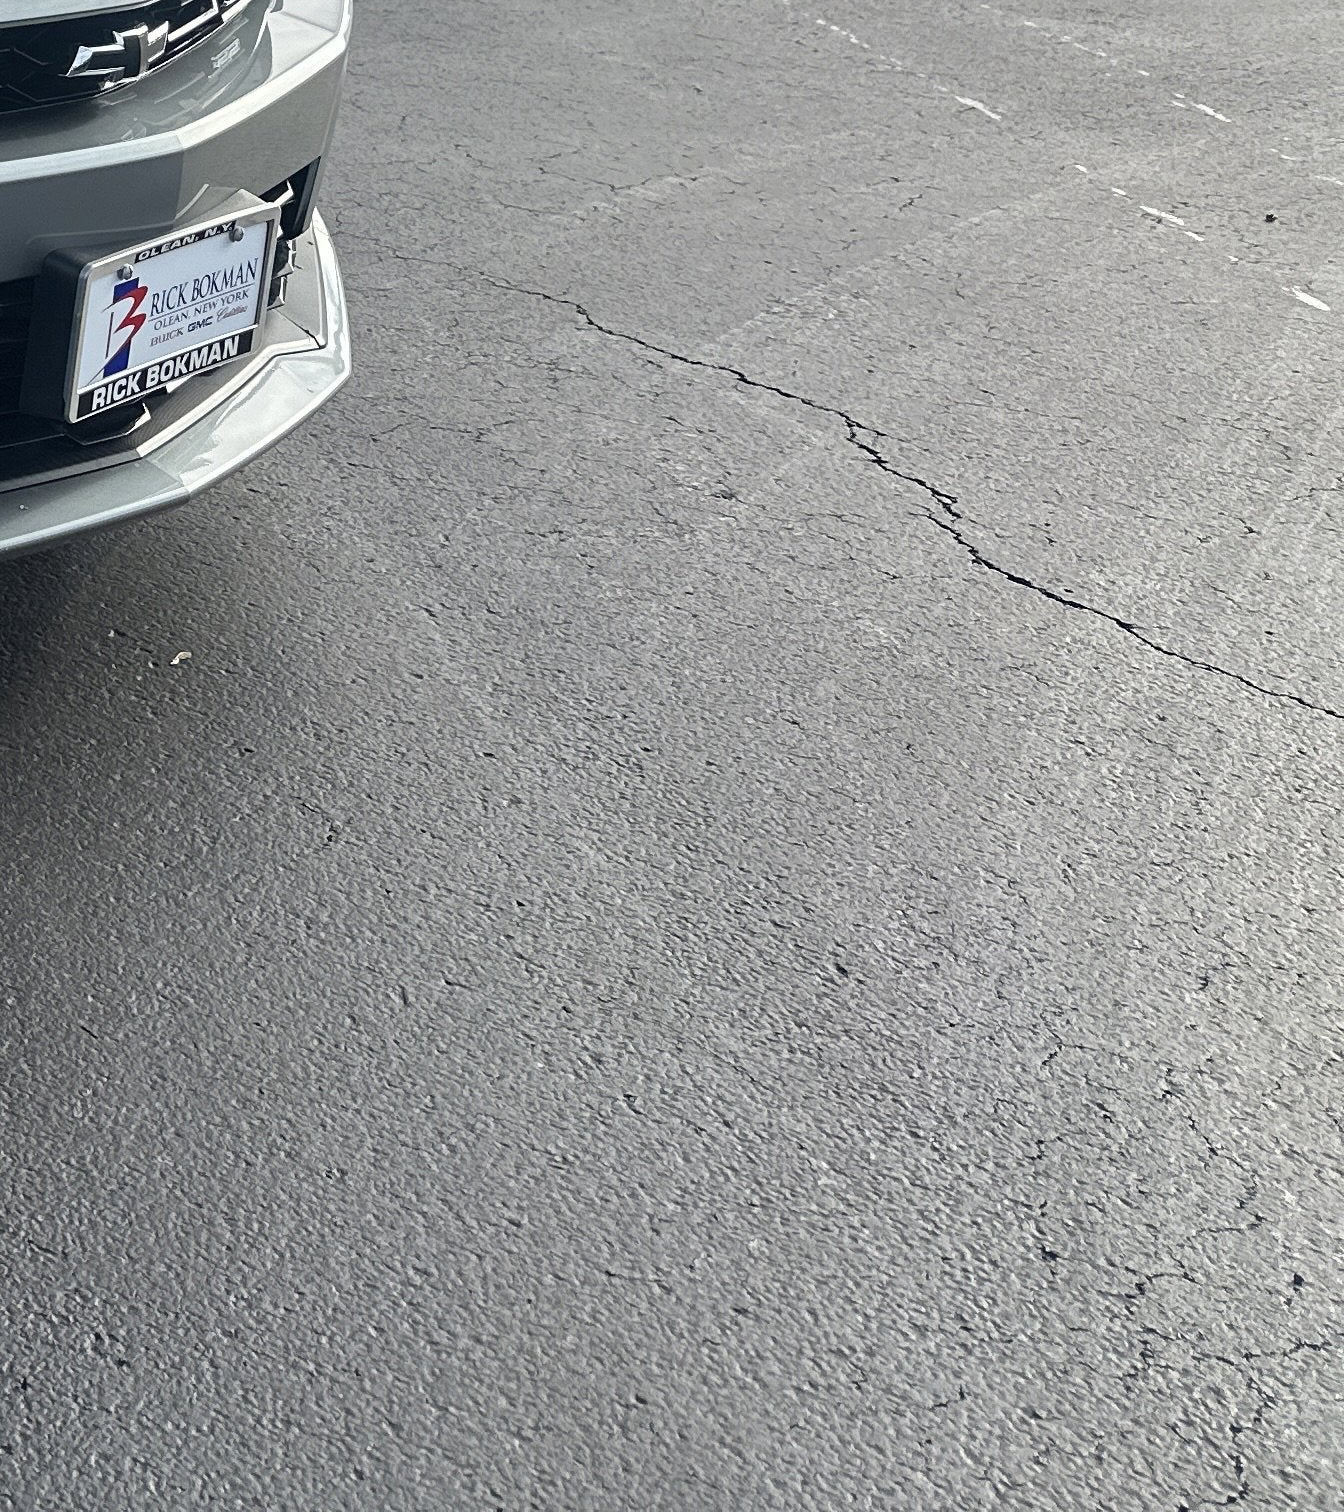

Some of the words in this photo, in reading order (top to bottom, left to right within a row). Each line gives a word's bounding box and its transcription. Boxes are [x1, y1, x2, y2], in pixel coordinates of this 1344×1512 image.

[150, 281, 189, 317] RICK
[190, 257, 259, 303] BOKMAN
[194, 298, 220, 316] NEW
[220, 289, 250, 306] YORK
[150, 327, 185, 347] BUICK
[187, 315, 214, 332] GMC
[90, 376, 143, 412] RICK
[145, 335, 241, 389] BOKMAN
